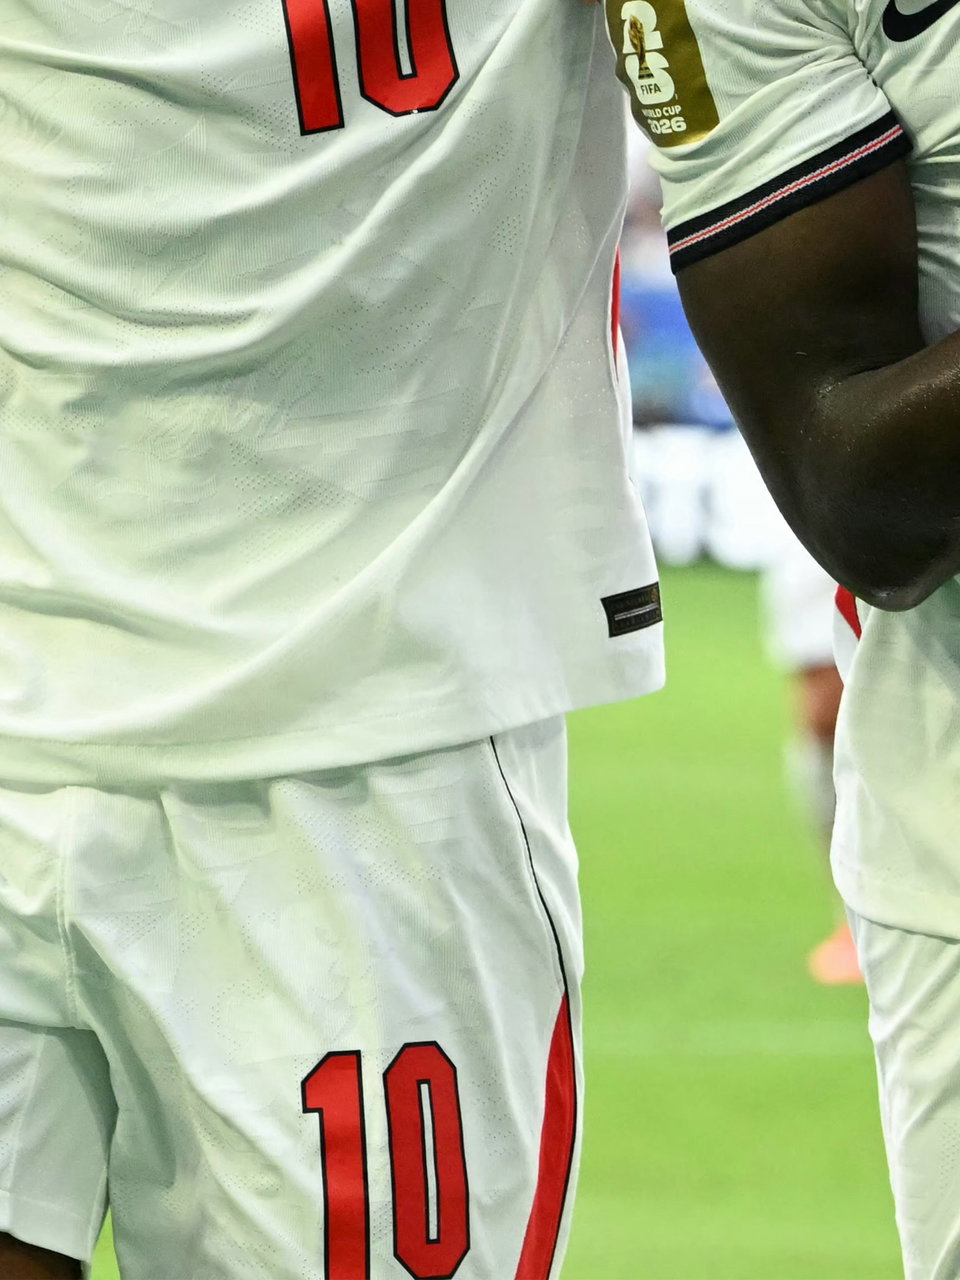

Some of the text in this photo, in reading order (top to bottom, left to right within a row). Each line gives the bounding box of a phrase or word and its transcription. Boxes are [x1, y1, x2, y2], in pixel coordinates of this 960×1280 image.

[640, 83, 662, 95] FIFA
[662, 104, 682, 116] CUP
[301, 1040, 470, 1280] 10
